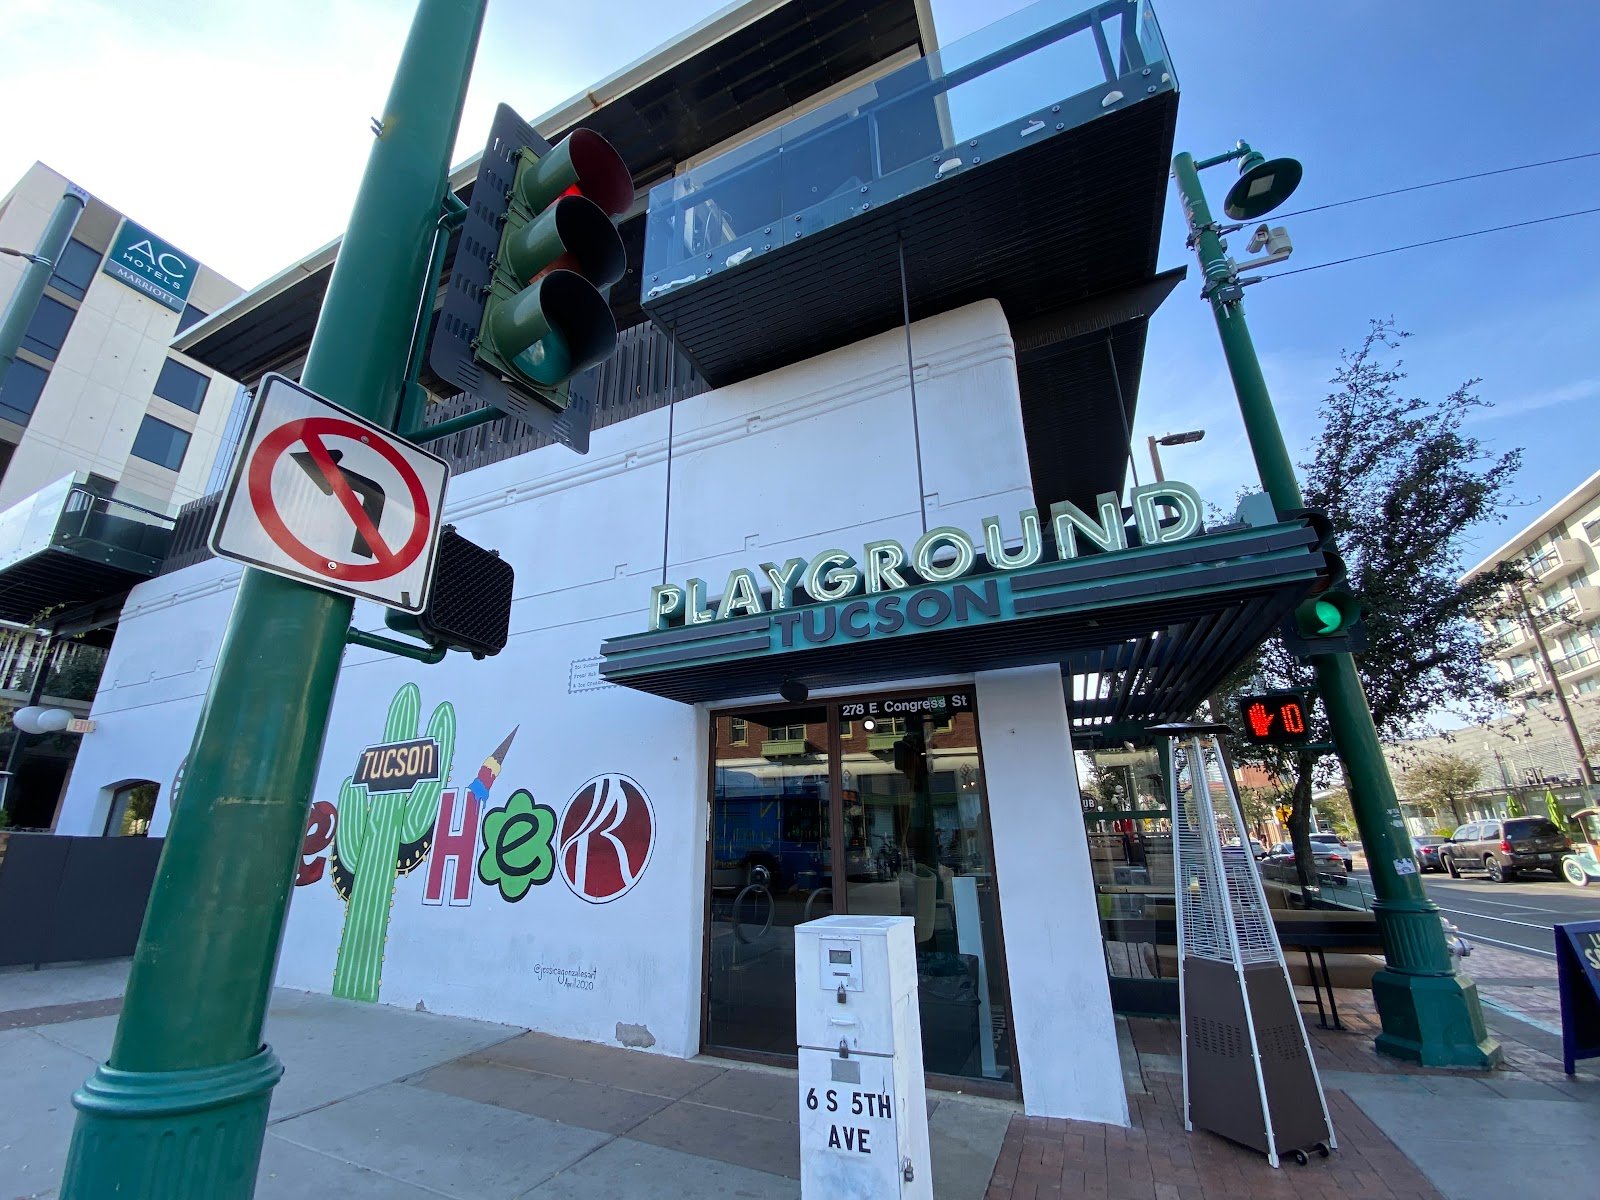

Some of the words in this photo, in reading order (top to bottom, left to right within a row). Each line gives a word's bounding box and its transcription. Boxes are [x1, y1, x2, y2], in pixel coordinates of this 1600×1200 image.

[123, 252, 181, 290] HOTELS
[127, 240, 187, 278] AC
[117, 268, 175, 303] MARRIOTT
[648, 480, 1203, 631] PLAYGROUND
[774, 579, 1001, 648] TUCSON
[842, 704, 865, 716] 278
[869, 702, 880, 714] E.
[884, 699, 947, 713] Congress
[951, 694, 967, 707] St
[1280, 703, 1304, 733] 10
[1082, 798, 1095, 808] UB
[533, 962, 597, 984] @jessicagonzalesart
[576, 979, 594, 991] 2020
[806, 1087, 819, 1111] 6
[826, 1089, 839, 1112] S
[851, 1092, 892, 1119] 5TH
[828, 1124, 871, 1154] AVE
